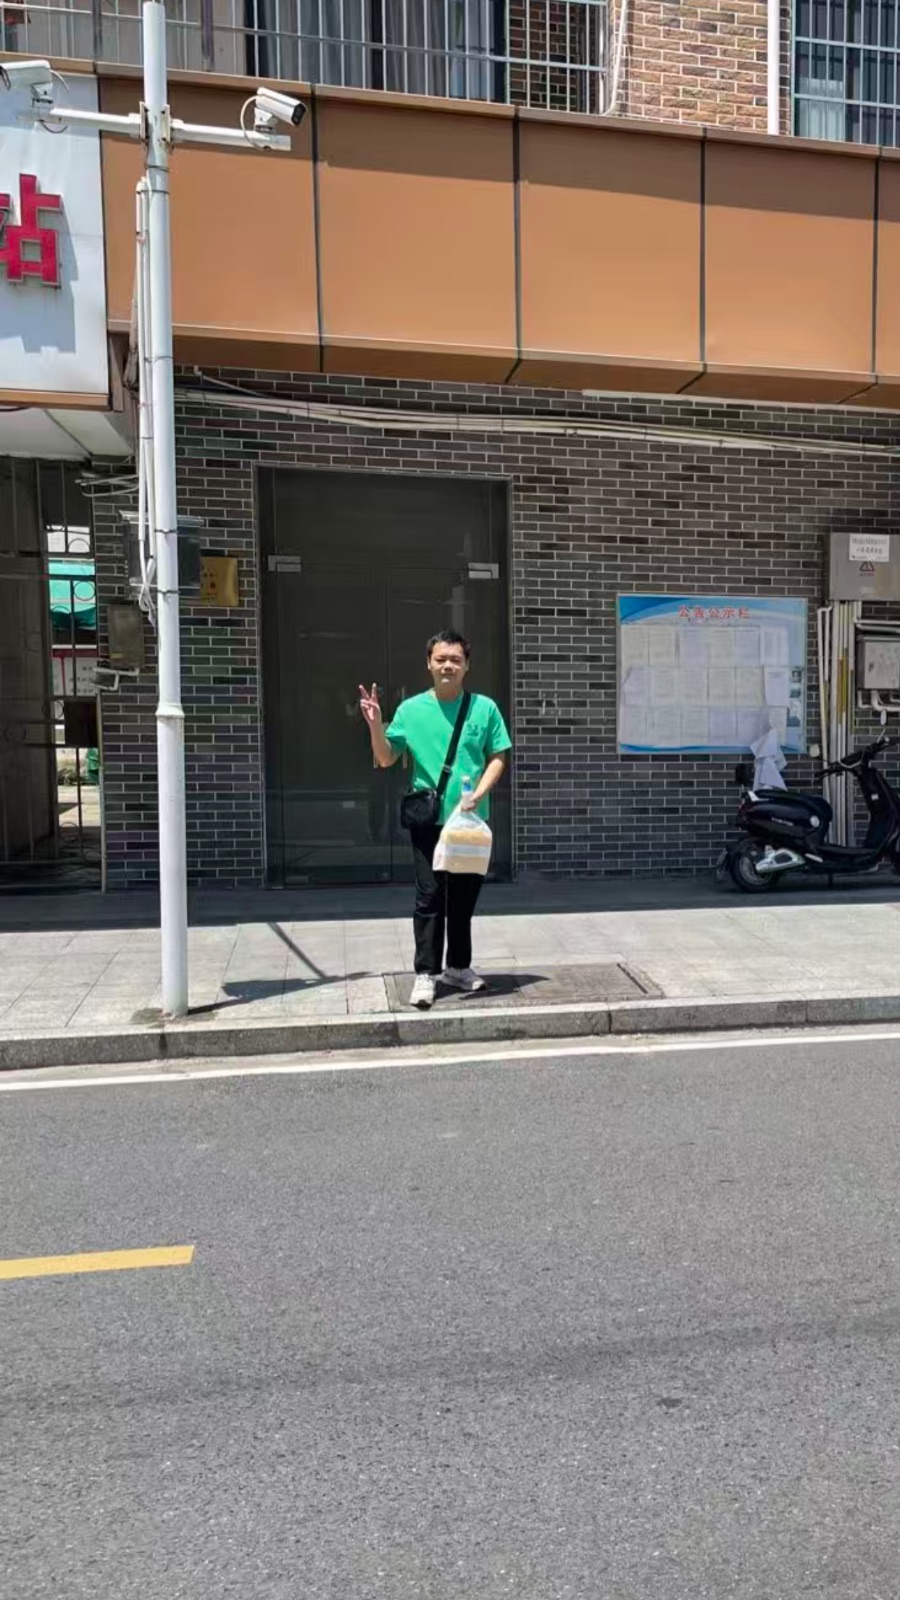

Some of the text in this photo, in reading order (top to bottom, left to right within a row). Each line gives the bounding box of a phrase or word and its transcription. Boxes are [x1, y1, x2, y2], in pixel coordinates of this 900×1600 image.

[0, 173, 62, 286] 站
[678, 605, 750, 619] 公告公示栏
